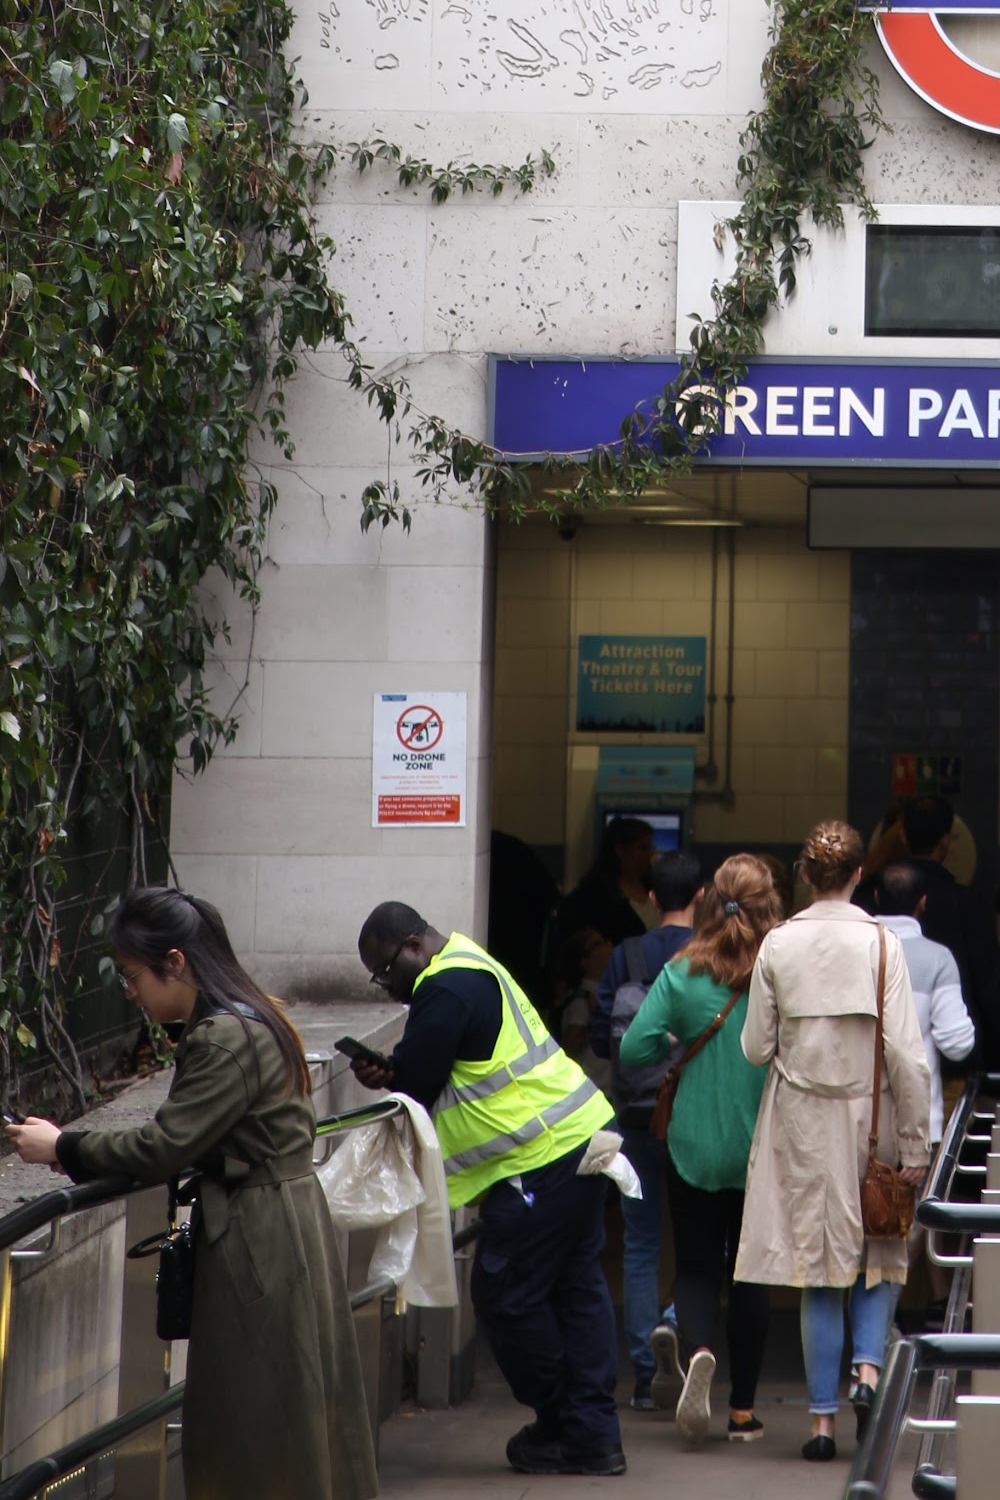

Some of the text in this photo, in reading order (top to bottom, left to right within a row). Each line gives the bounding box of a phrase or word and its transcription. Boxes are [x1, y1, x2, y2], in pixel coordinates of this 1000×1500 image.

[674, 384, 885, 437] GREEN
[599, 643, 685, 658] Attraction
[581, 660, 703, 677] Theatre & Tour
[590, 677, 693, 694] Tickets Here
[392, 753, 446, 761] NO DRONE
[405, 762, 433, 770] ZONE
